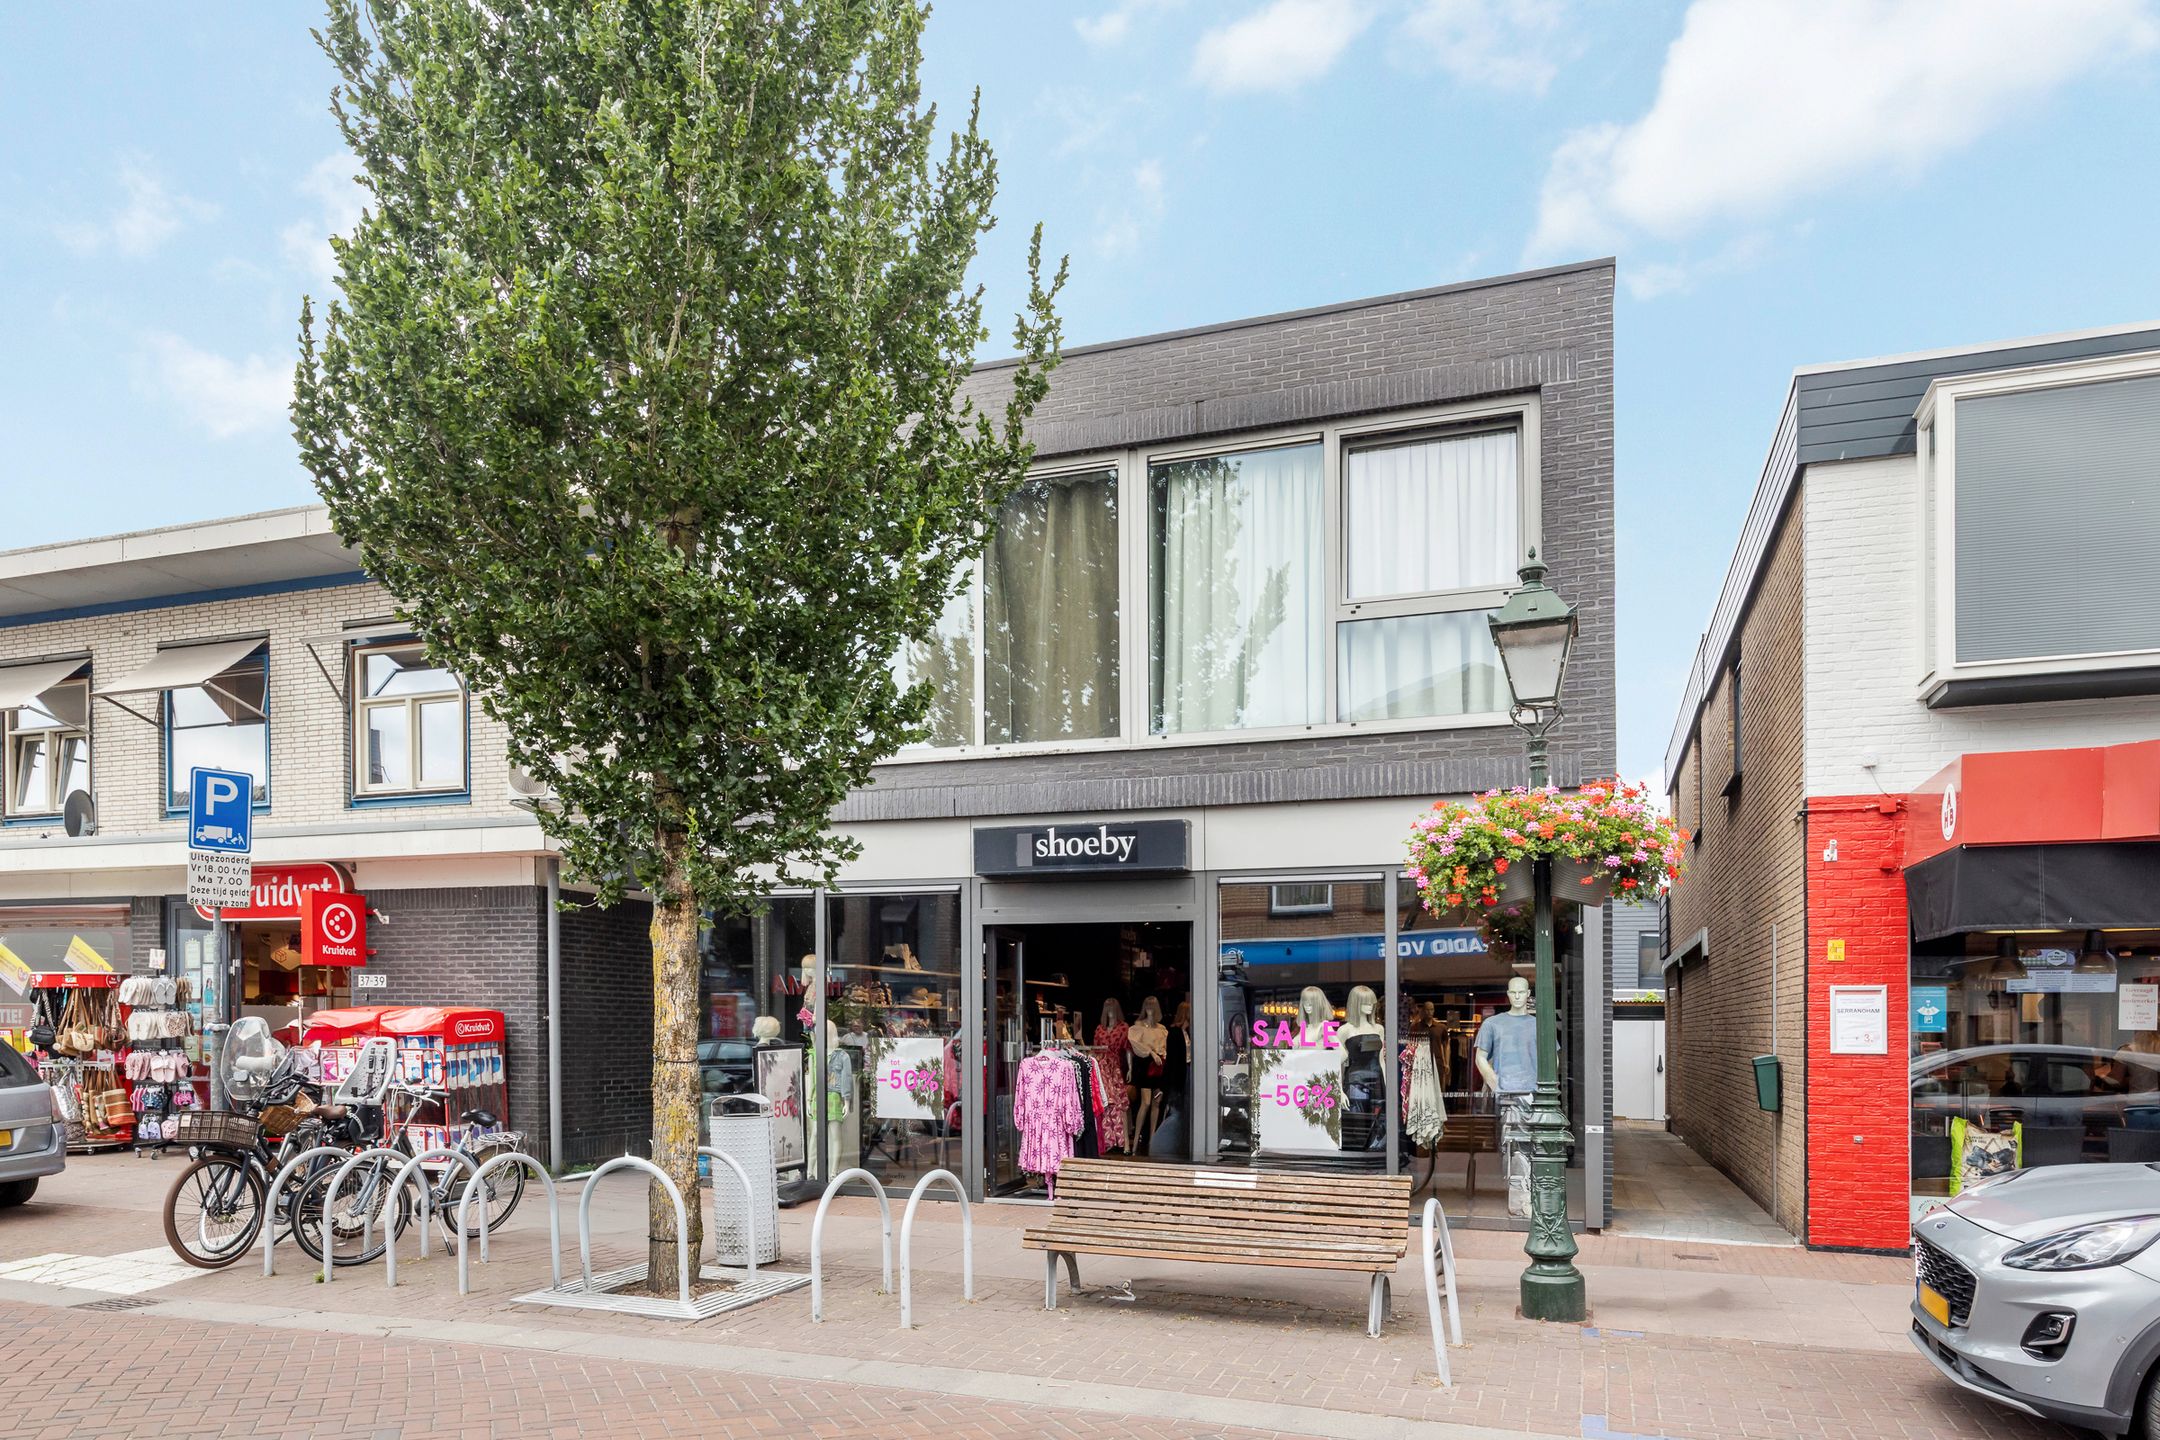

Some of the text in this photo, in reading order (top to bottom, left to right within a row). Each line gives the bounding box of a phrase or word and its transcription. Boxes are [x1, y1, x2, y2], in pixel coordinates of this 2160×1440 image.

[206, 776, 238, 815] P
[1036, 825, 1136, 862] shoeby
[190, 853, 250, 864] Uitgezonderd
[204, 865, 230, 874] 18.00
[232, 867, 250, 875] t/m
[197, 875, 243, 886] Ma 7.00
[190, 885, 250, 898] Deze tijd geldt
[201, 898, 229, 906] blauwe
[231, 900, 249, 908] zone
[322, 945, 357, 957] Kruidvat
[359, 976, 385, 986] 37-39
[1252, 1020, 1340, 1047] SALE
[878, 1069, 939, 1092] -50%
[1260, 1084, 1336, 1108] -50%
